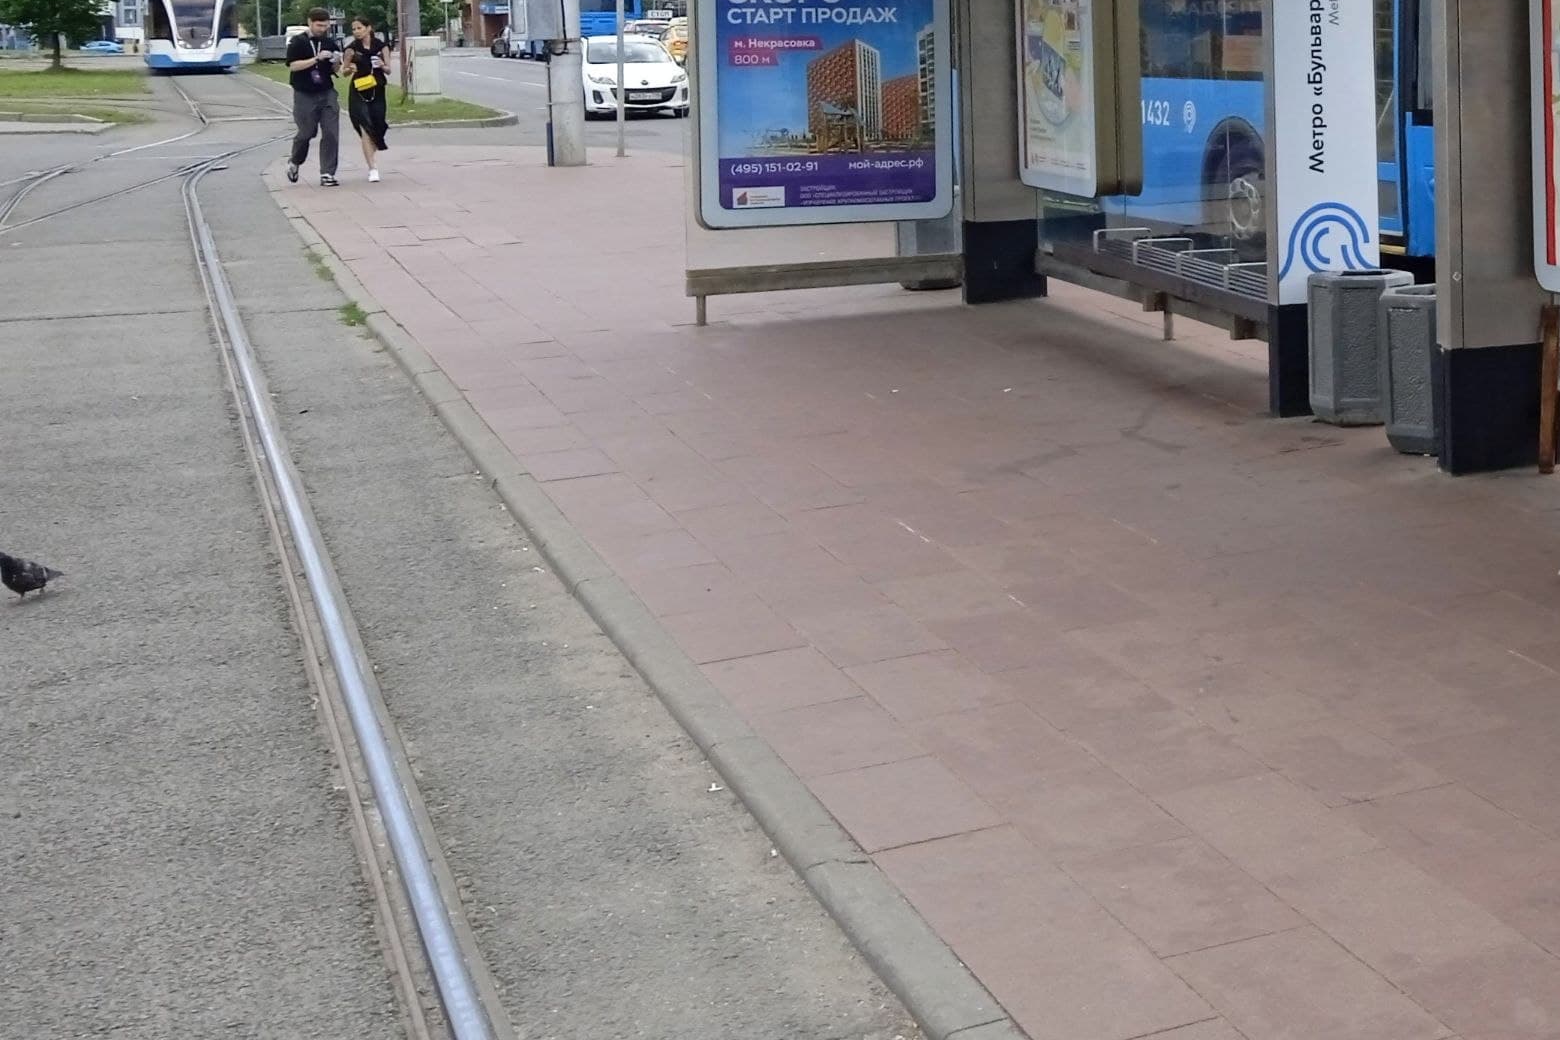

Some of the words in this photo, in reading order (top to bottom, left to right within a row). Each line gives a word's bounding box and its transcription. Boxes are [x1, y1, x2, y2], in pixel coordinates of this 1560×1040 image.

[726, 7, 797, 25] СТАРТ
[801, 7, 898, 25] ПРОДАЖ
[748, 38, 816, 50] Некрасовка
[1307, 0, 1326, 96] «Бульвар
[734, 54, 759, 64] 800
[1308, 103, 1327, 173] Метро
[730, 162, 762, 176] (495)
[765, 160, 819, 173] 151-02-91
[848, 157, 924, 171] мой-адрес.рф
